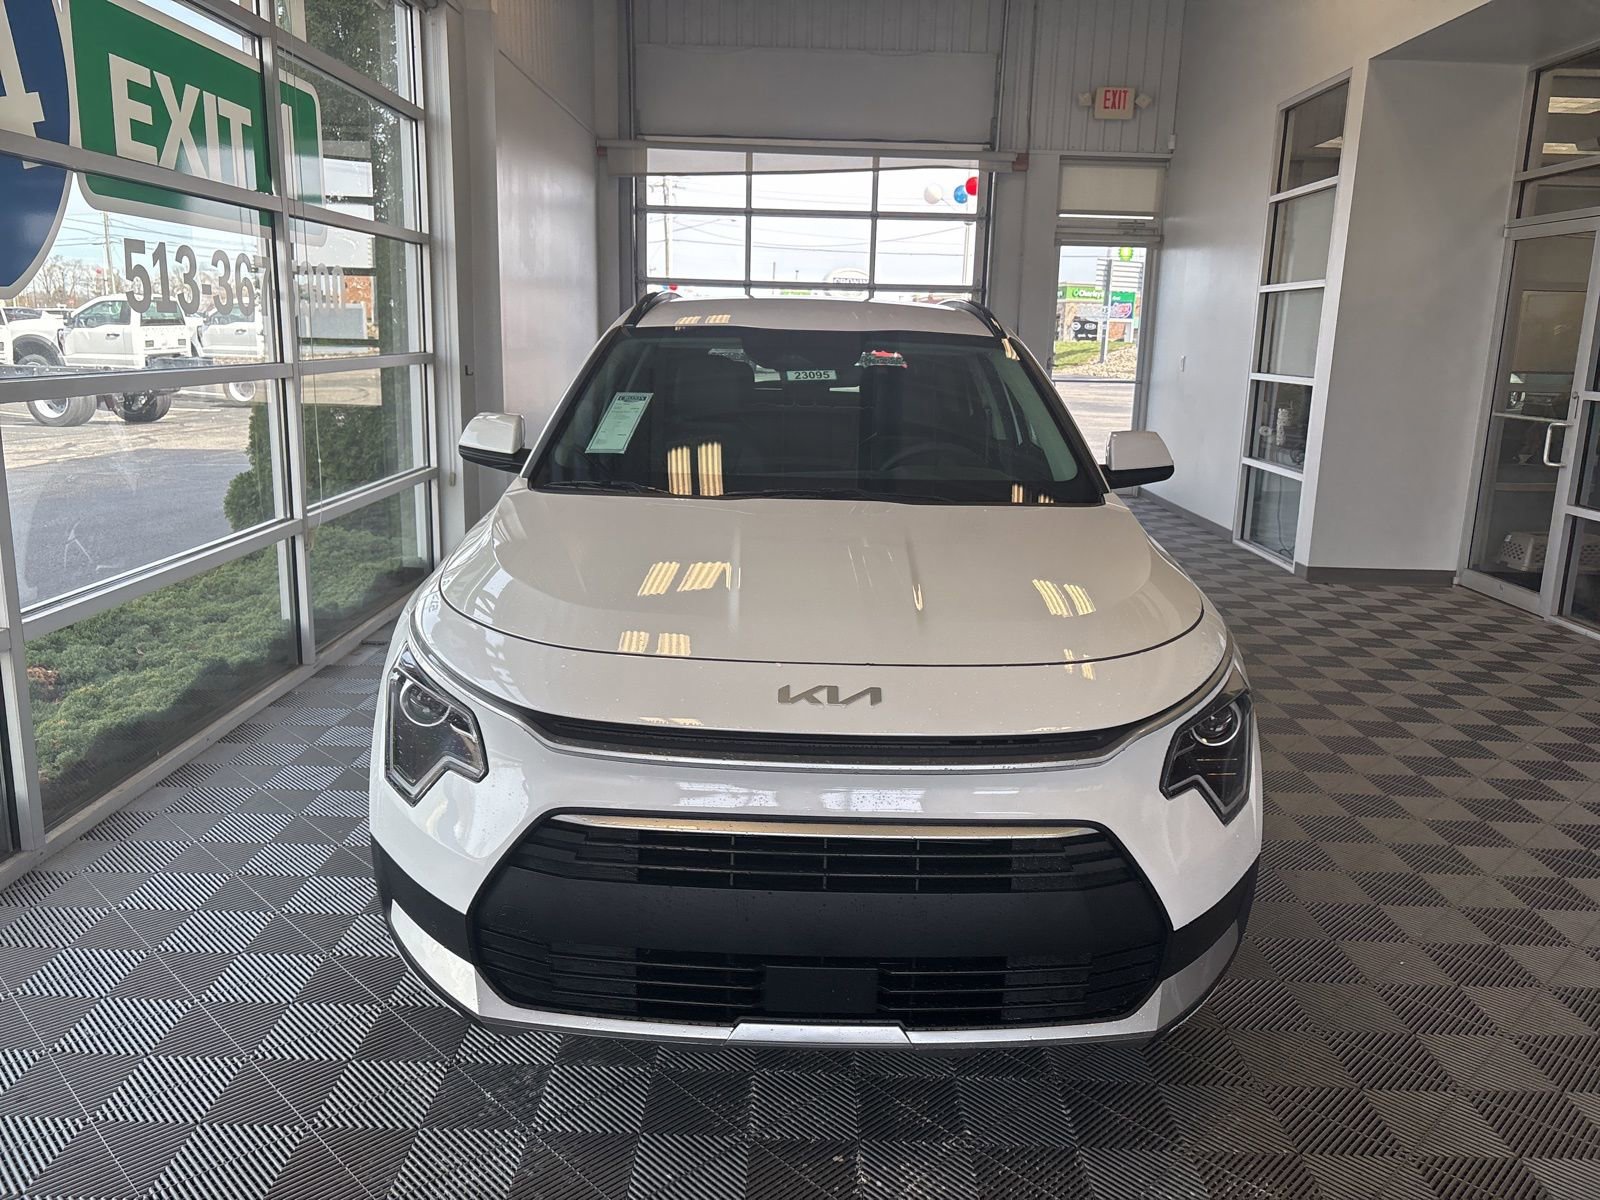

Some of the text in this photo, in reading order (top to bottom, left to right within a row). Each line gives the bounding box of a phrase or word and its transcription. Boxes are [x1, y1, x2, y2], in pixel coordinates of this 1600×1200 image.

[1103, 88, 1129, 110] EXIT
[108, 53, 257, 191] EXIT
[794, 371, 830, 380] 23095
[778, 684, 882, 706] KIA
